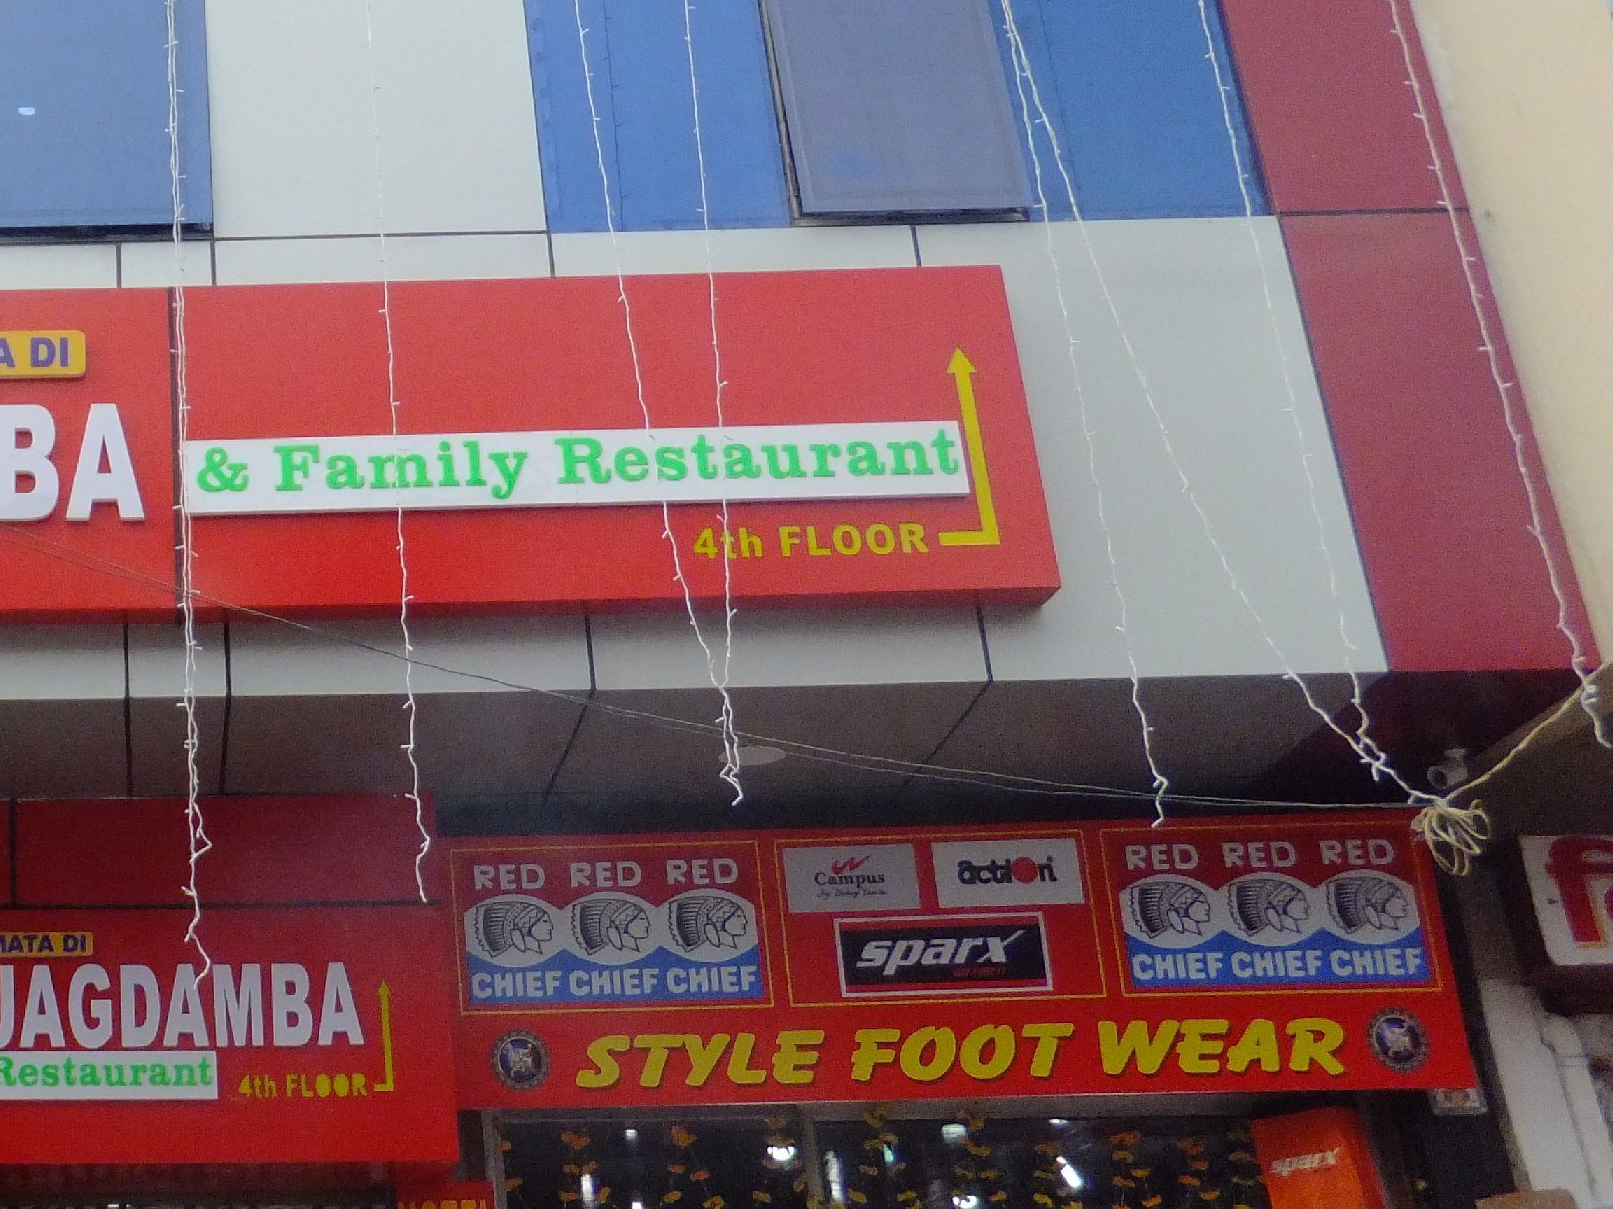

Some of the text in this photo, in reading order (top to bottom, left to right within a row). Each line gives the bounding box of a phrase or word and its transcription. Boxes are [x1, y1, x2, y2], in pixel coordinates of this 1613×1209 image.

[30, 336, 69, 368] DI
[195, 427, 960, 499] & Family Restaurant
[693, 523, 929, 559] 4th FLOOR
[1125, 838, 1395, 870] RED RED RED
[473, 857, 739, 891] RED RED RED
[813, 872, 886, 888] Campus
[62, 933, 87, 951] DI
[856, 930, 1026, 975] sparx
[1132, 947, 1423, 980] CHIEF CHIEF CHIEF
[471, 966, 758, 999] CHIEF CHIEF CHIEF
[575, 1017, 1345, 1089] STYLE FOOT WEAR
[238, 1073, 368, 1099] 4th FLOOR
